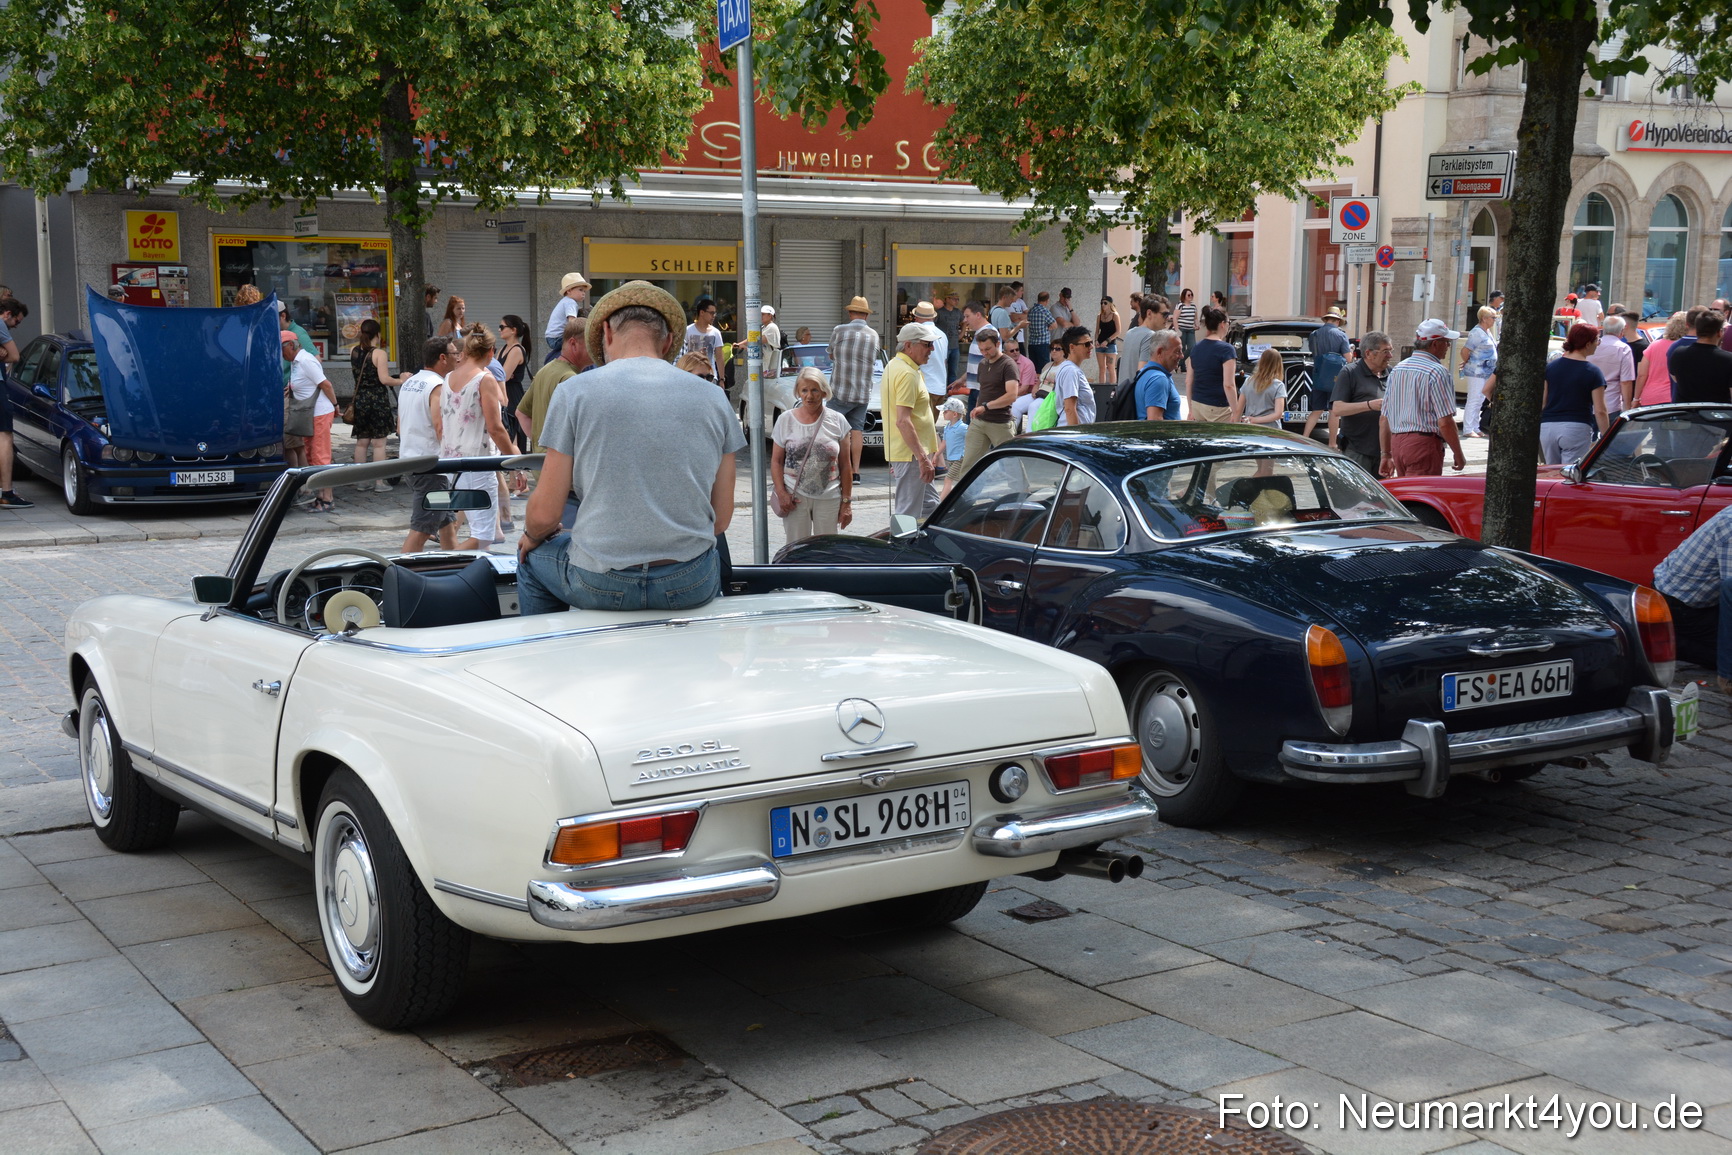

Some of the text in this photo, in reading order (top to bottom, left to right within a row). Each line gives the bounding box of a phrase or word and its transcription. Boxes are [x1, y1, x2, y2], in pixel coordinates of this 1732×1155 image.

[720, 0, 746, 33] TAXI
[777, 148, 873, 169] juwelier
[1441, 159, 1493, 173] Parkleitsystem
[1456, 181, 1492, 193] Rosengasse
[486, 220, 497, 228] 41
[1342, 232, 1366, 240] ZONE
[133, 238, 174, 249] LOTTO
[651, 259, 735, 272] SCHLIERF
[949, 263, 1022, 275] SCHLIERF
[177, 473, 192, 483] NM
[207, 472, 227, 482] 538
[1456, 665, 1570, 705] FS EA 66H
[1446, 696, 1452, 704] D
[702, 739, 732, 752] SL
[638, 756, 741, 781] AUTOMATIC
[953, 787, 966, 799] 04
[792, 789, 950, 848] N SL 968H
[955, 812, 967, 823] 10
[778, 837, 786, 848] D
